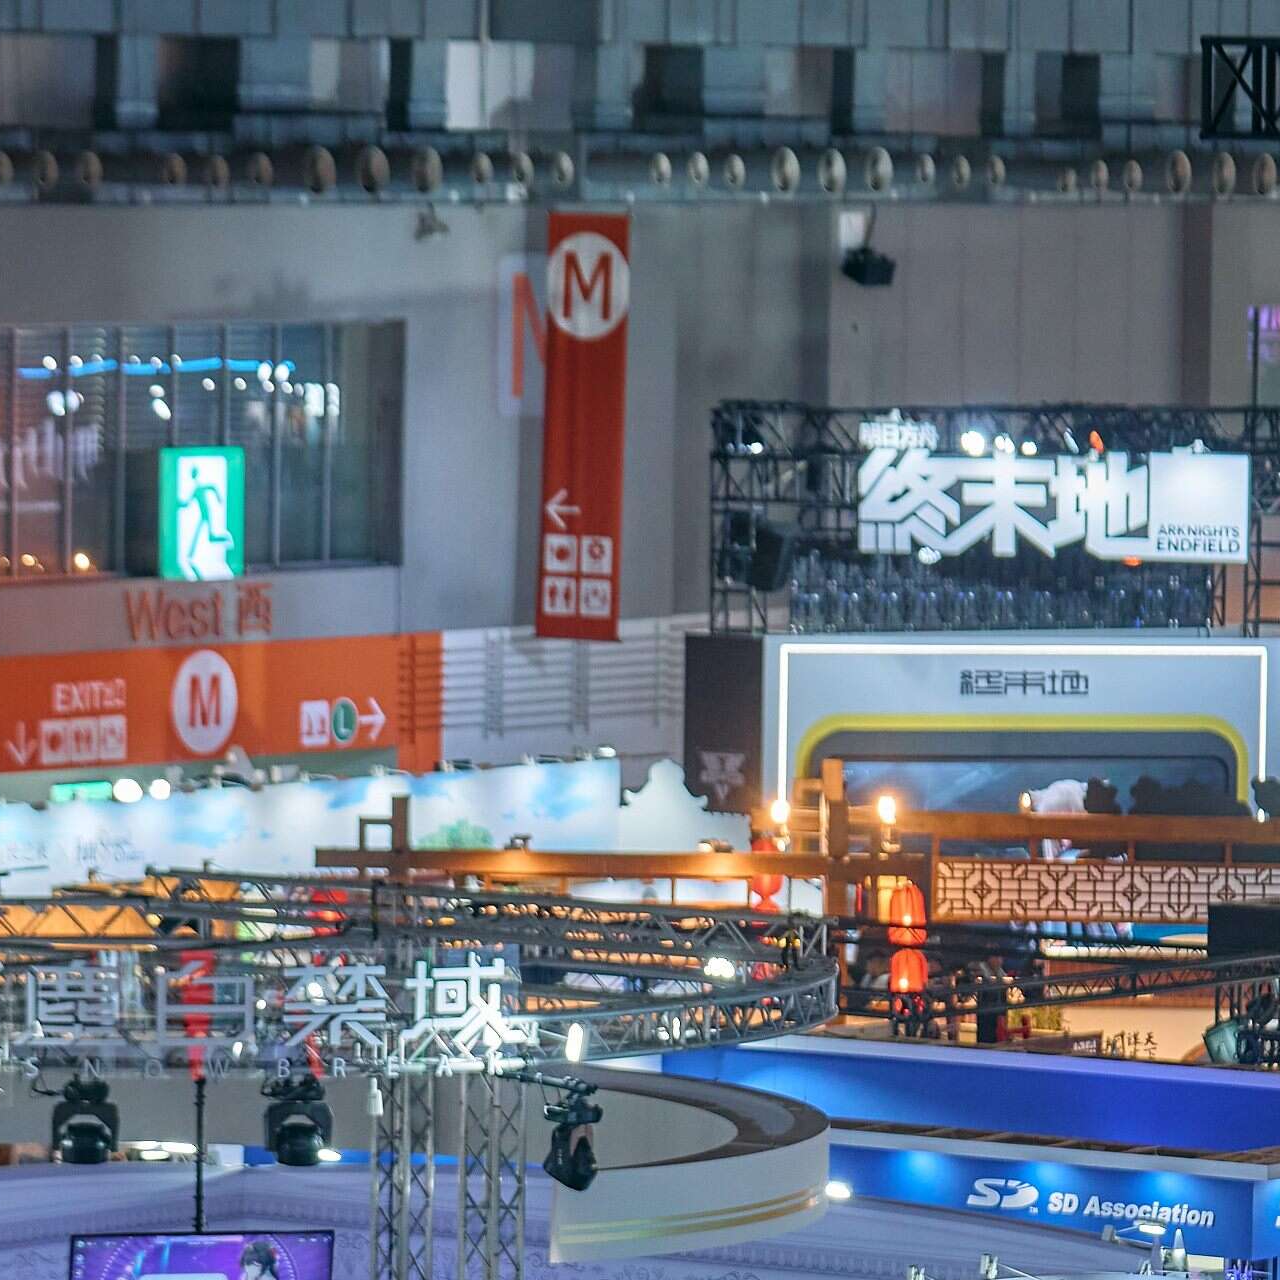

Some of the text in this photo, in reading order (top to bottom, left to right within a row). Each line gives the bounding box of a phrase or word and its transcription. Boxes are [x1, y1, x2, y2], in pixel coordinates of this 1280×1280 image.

[563, 251, 613, 321] M
[1156, 538, 1241, 554] ENDFIELD
[1158, 525, 1241, 539] ARKNIGHTS
[124, 583, 272, 643] West 西
[53, 681, 104, 713] EXIT
[188, 673, 220, 729] M
[15, 951, 526, 1047] 塵白禁域
[25, 1058, 505, 1079] SNOWBREAK
[1047, 1191, 1077, 1214] SD
[1083, 1195, 1215, 1227] Association
